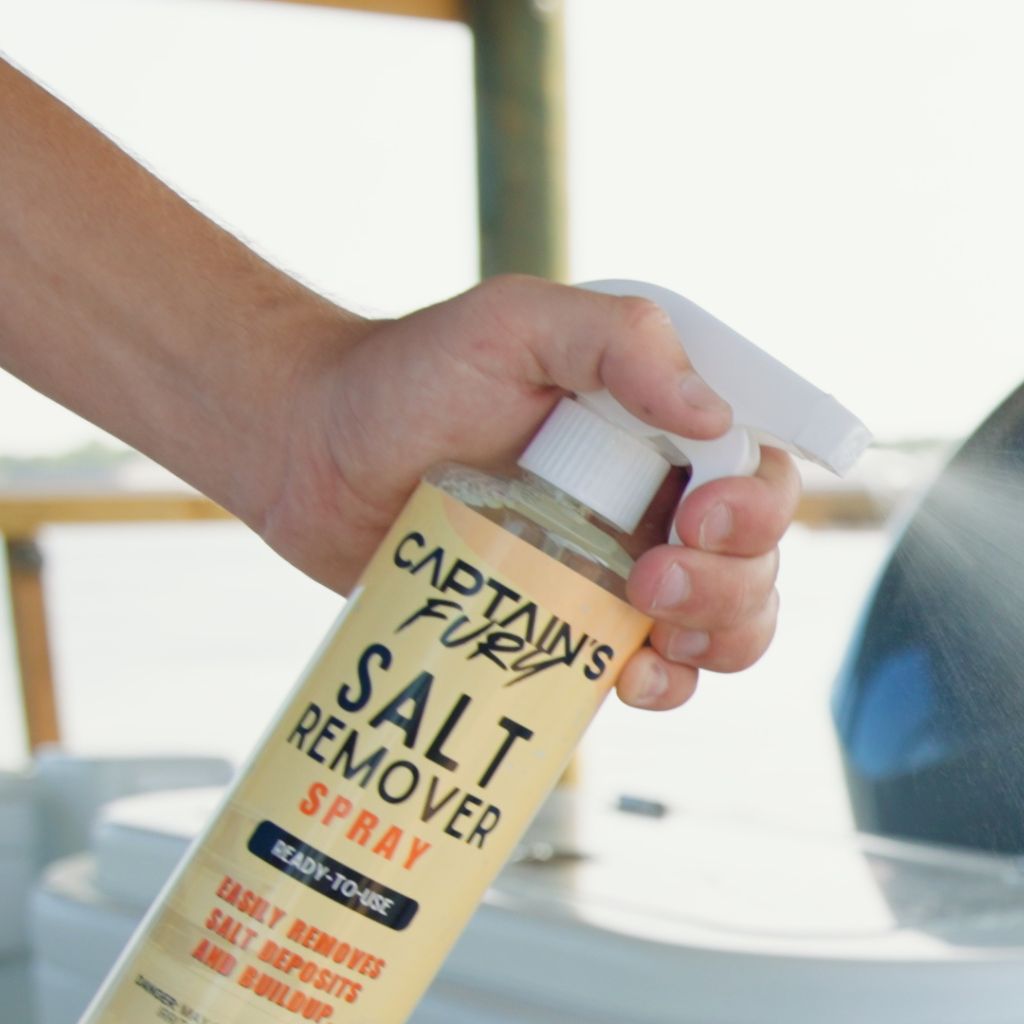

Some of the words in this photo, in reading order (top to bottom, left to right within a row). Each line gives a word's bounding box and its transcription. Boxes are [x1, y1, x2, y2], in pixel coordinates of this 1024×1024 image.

[393, 531, 614, 681] CAPTAIN'S
[394, 598, 570, 687] FURY
[337, 643, 535, 789] SALT
[286, 702, 502, 849] REMOVER
[298, 781, 432, 871] SPRAY
[270, 839, 396, 917] READY-TO-USE
[191, 938, 238, 977] AND
[205, 907, 258, 951] SALT
[257, 939, 364, 1003] DEPOSITS
[215, 875, 286, 929] EASILY
[286, 918, 387, 979] REMOVES
